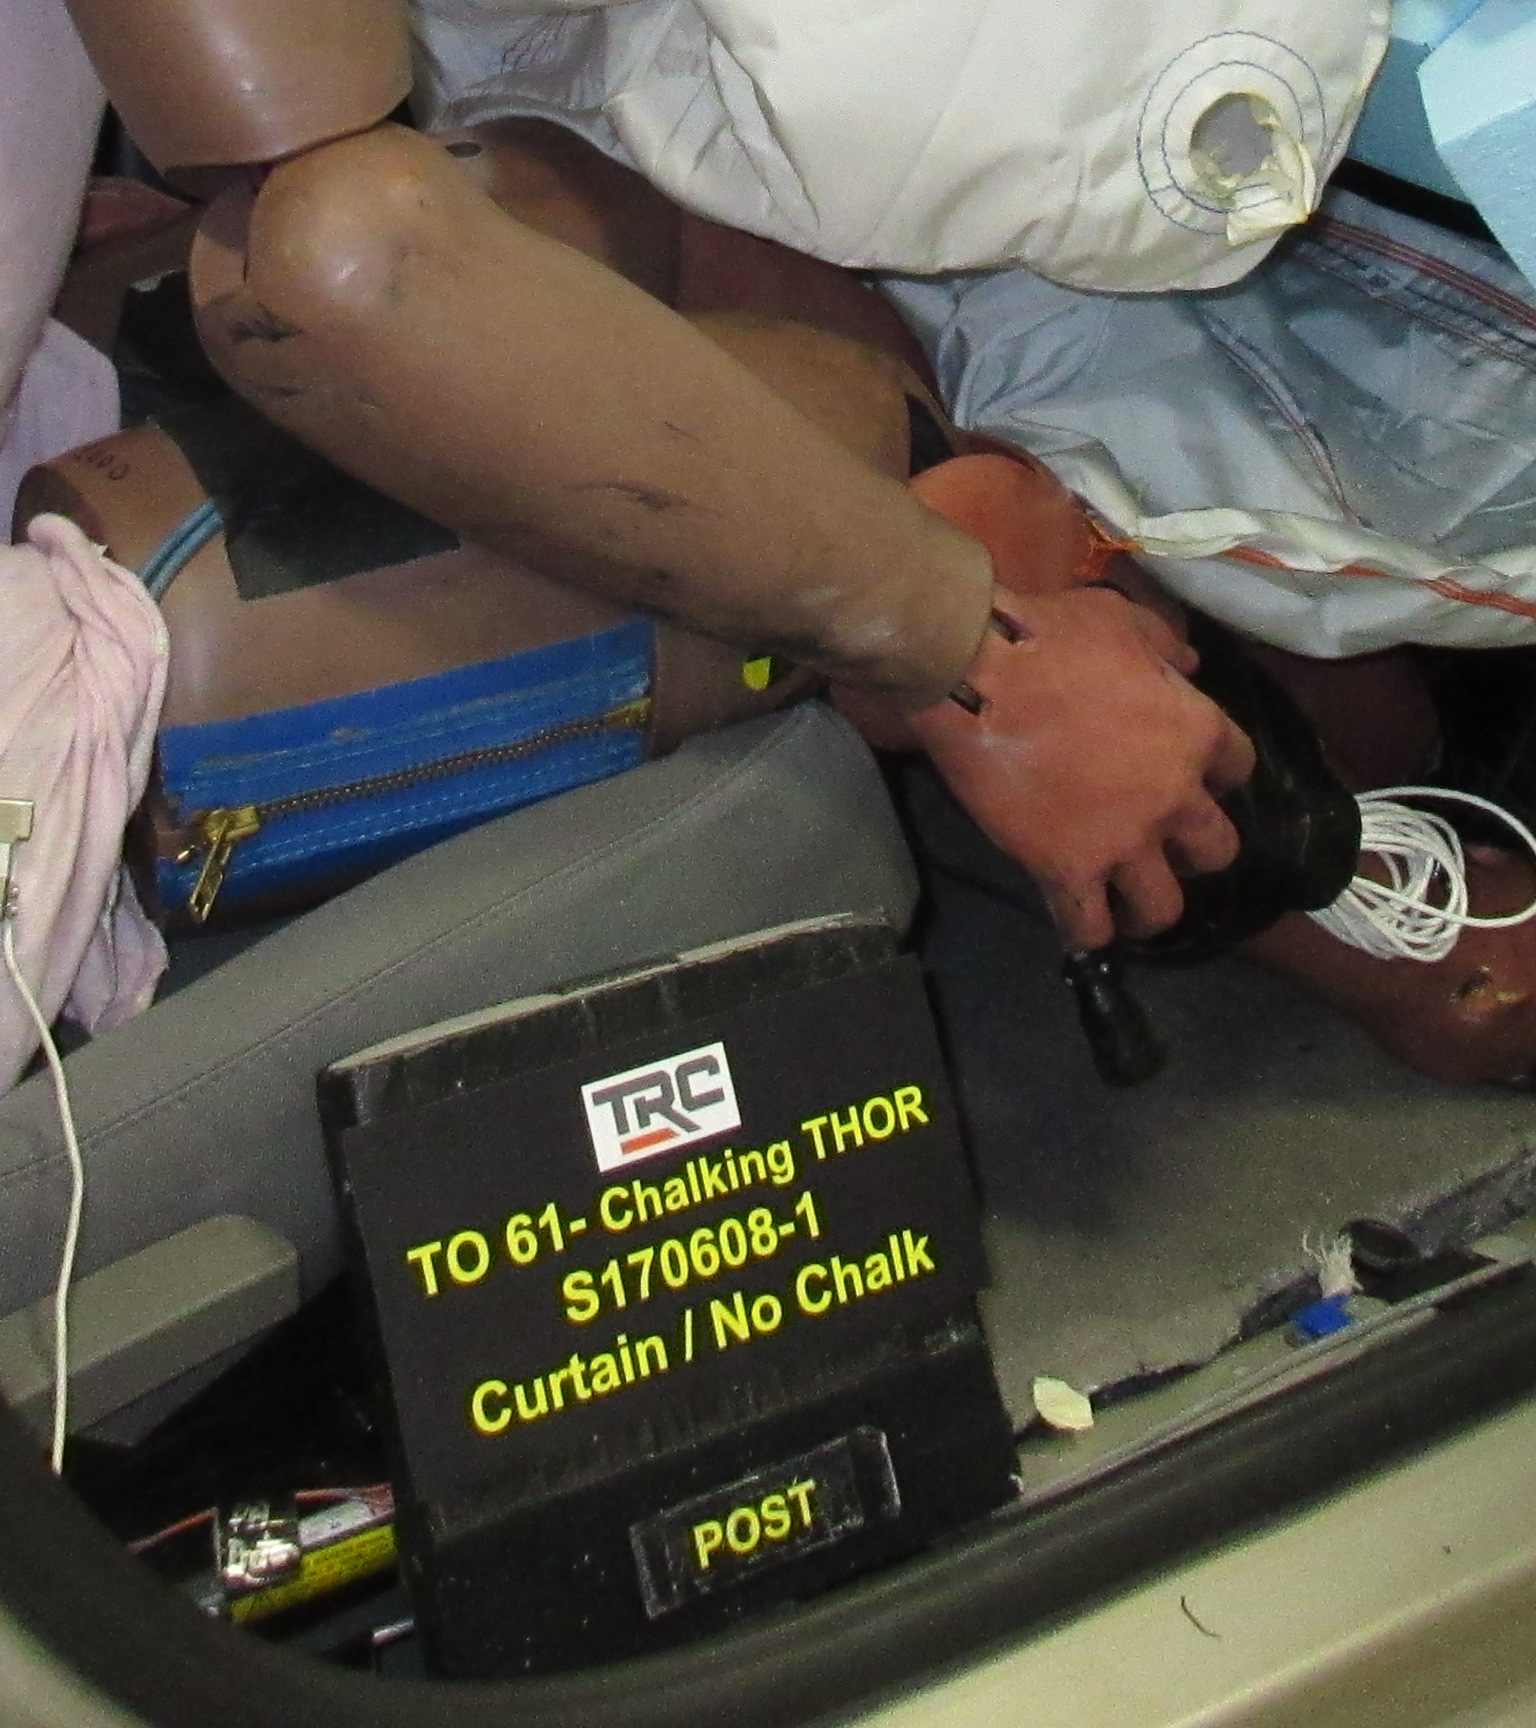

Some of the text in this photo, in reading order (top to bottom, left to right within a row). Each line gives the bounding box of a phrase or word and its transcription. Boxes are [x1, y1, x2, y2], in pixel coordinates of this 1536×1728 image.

[591, 1053, 727, 1137] TRC
[406, 1084, 930, 1299] TO 61- Chalking THOR
[561, 1190, 822, 1324] S170608-1
[471, 1227, 937, 1435] Curtain / No Chalk
[691, 1477, 819, 1571] POST
